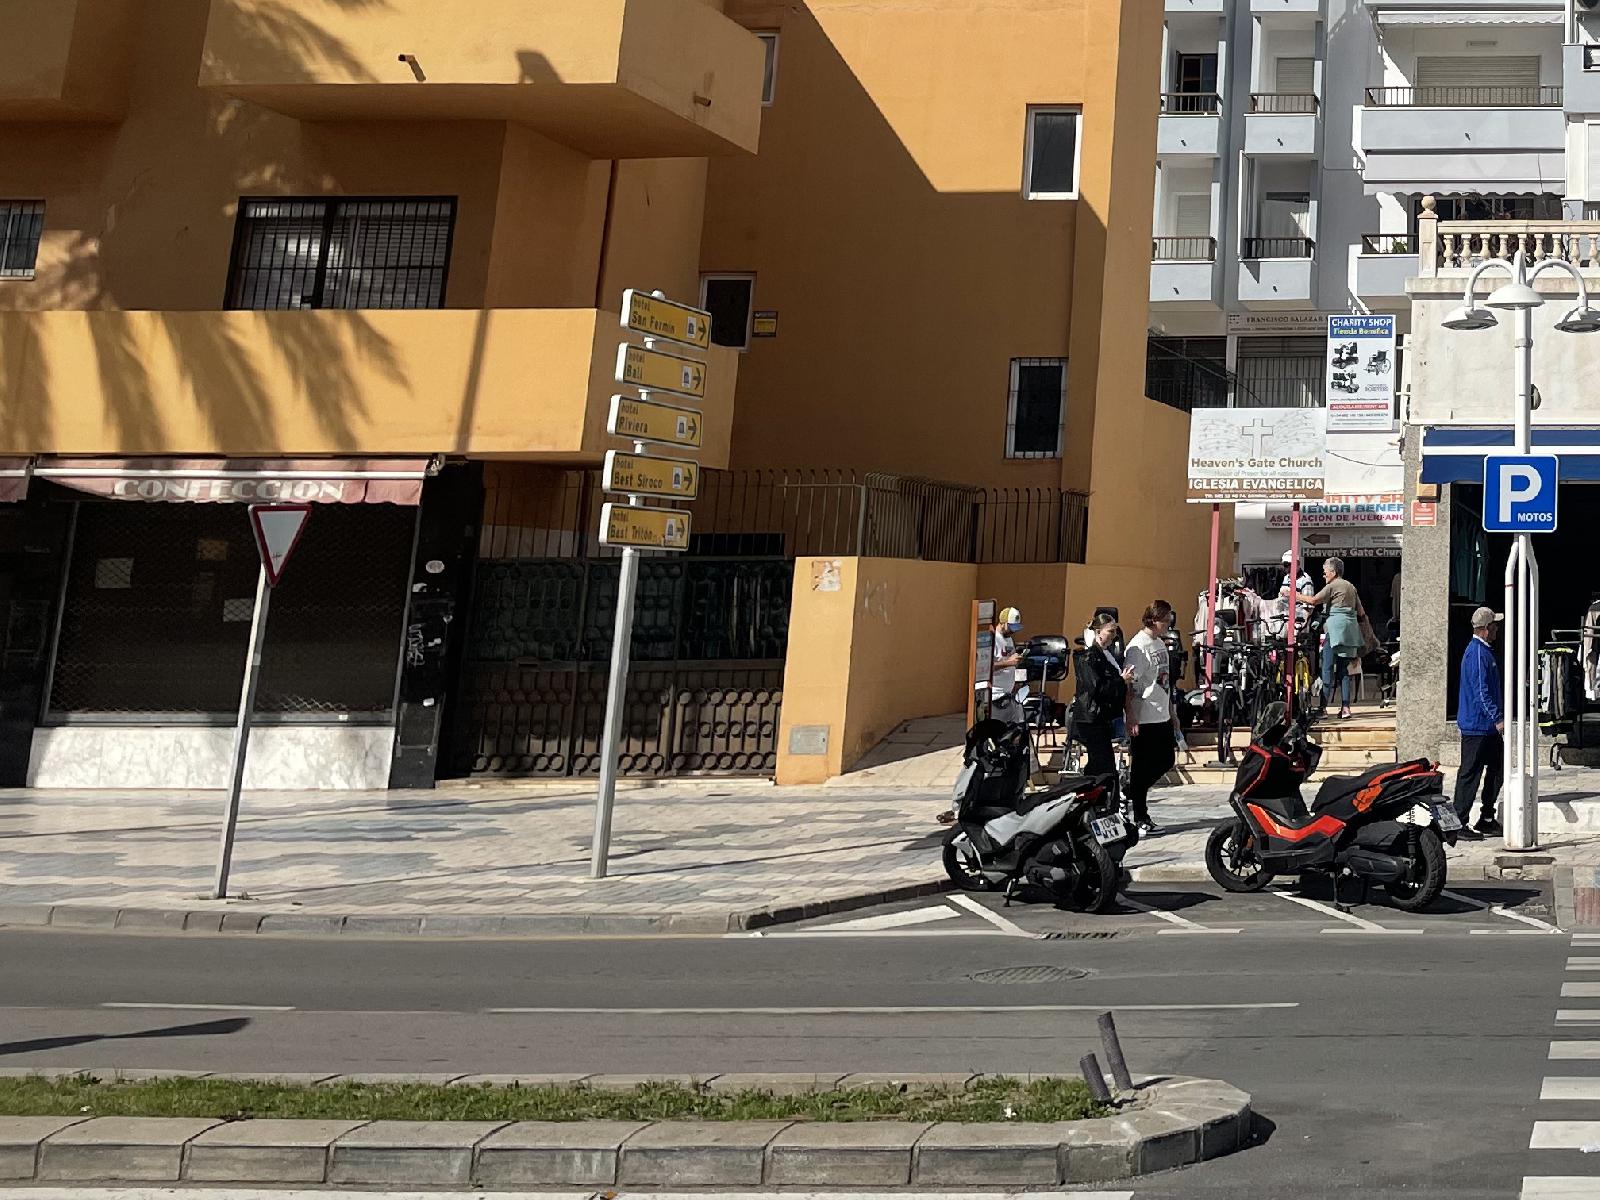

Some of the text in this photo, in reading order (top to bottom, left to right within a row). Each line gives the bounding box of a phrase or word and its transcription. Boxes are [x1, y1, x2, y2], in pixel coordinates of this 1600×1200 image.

[631, 311, 647, 327] San
[1331, 318, 1392, 327] CHARITY SHOP
[626, 365, 643, 380] Bali
[621, 402, 639, 415] hotel
[619, 417, 648, 434] Riviera
[616, 457, 634, 469] hotel
[1191, 457, 1323, 468] Heaven's Gate Church
[614, 472, 634, 487] Best
[1188, 479, 1324, 490] IGLESIA EVANGELICA
[1498, 463, 1542, 523] P
[1302, 504, 1351, 513] IENDA
[1517, 512, 1553, 523] MOTOS
[1302, 548, 1402, 557] Heaven's Gate Chur
